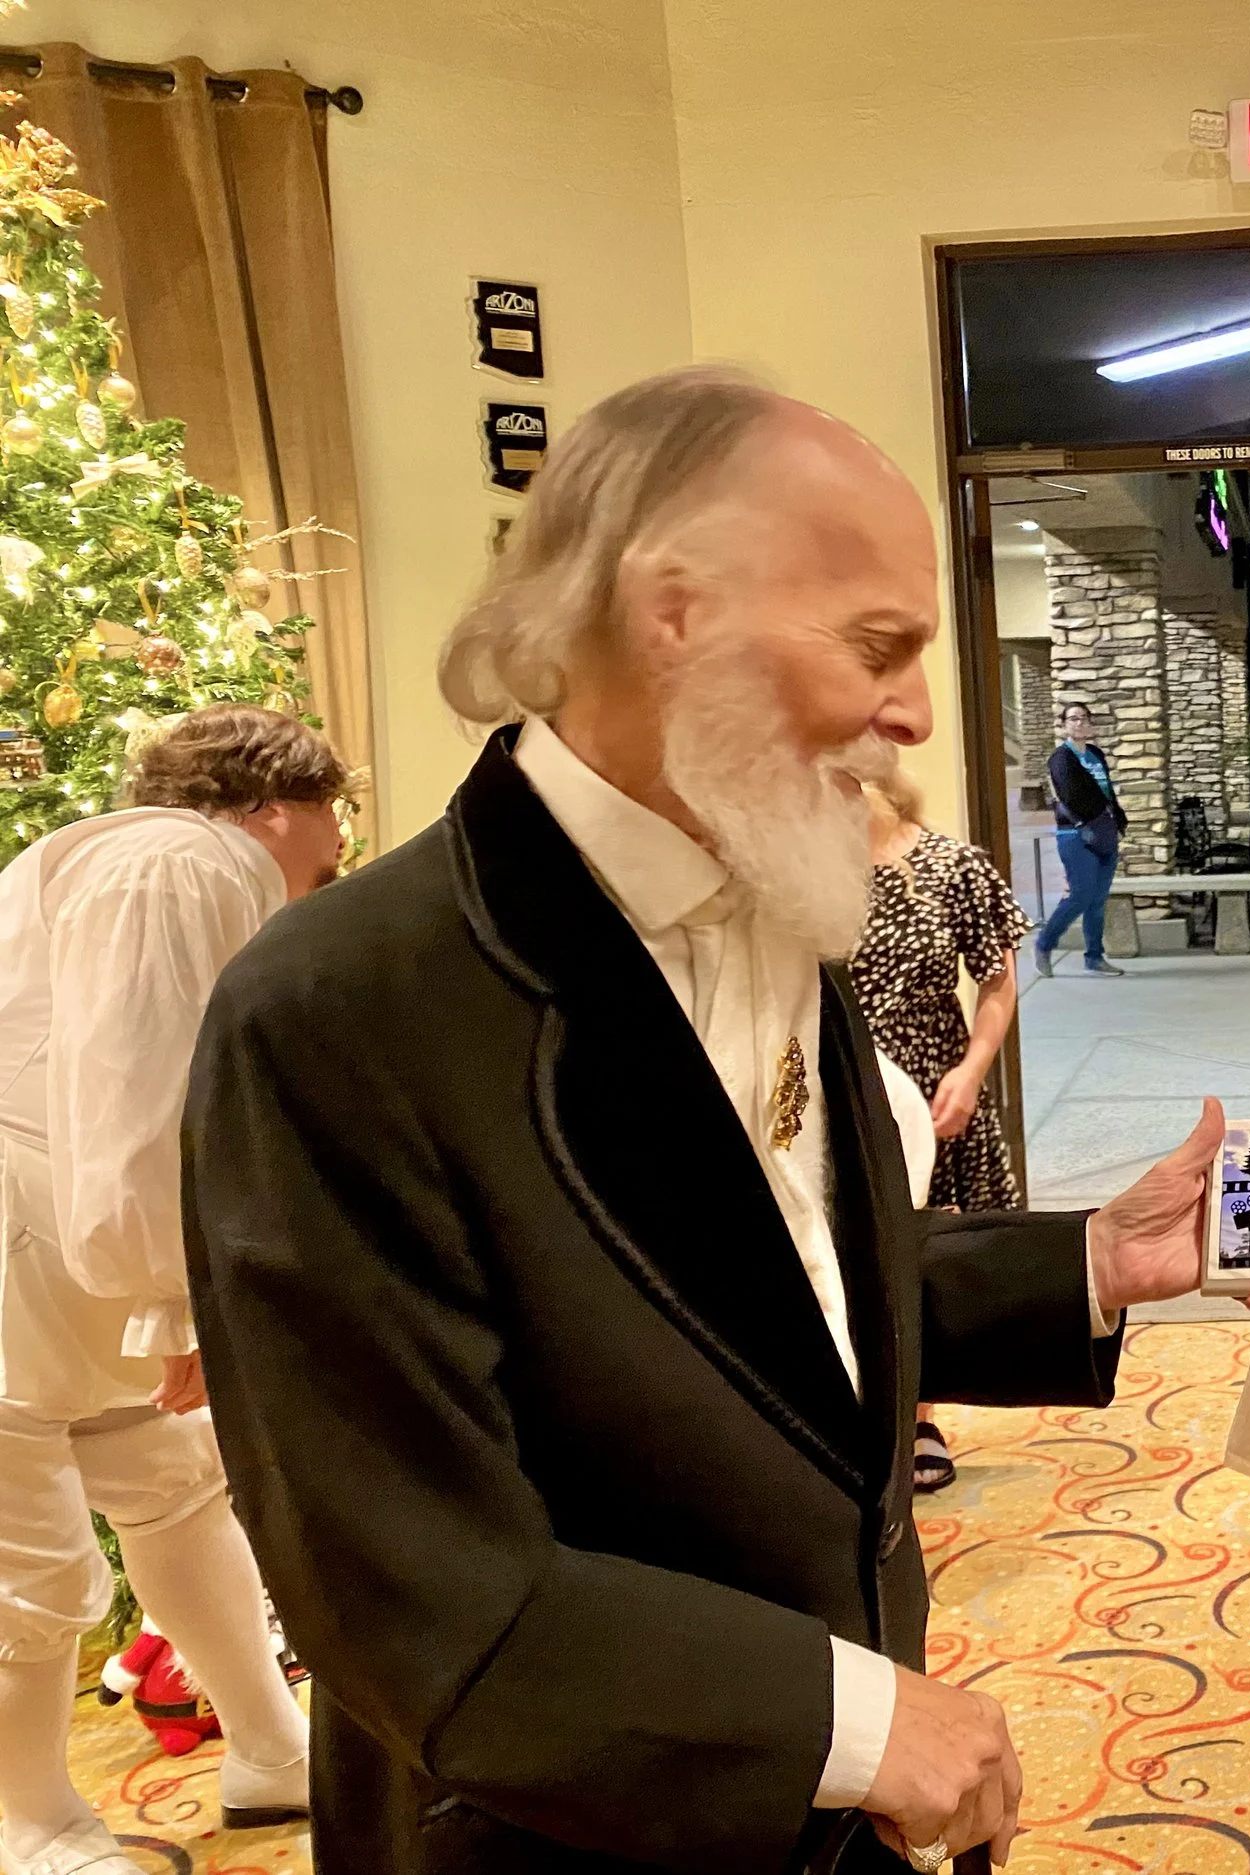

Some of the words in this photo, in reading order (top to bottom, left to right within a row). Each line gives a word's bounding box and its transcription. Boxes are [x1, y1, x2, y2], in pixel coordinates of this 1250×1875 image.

[1165, 449, 1192, 461] THESE
[1192, 447, 1221, 460] DOORS
[1222, 447, 1233, 459] TO
